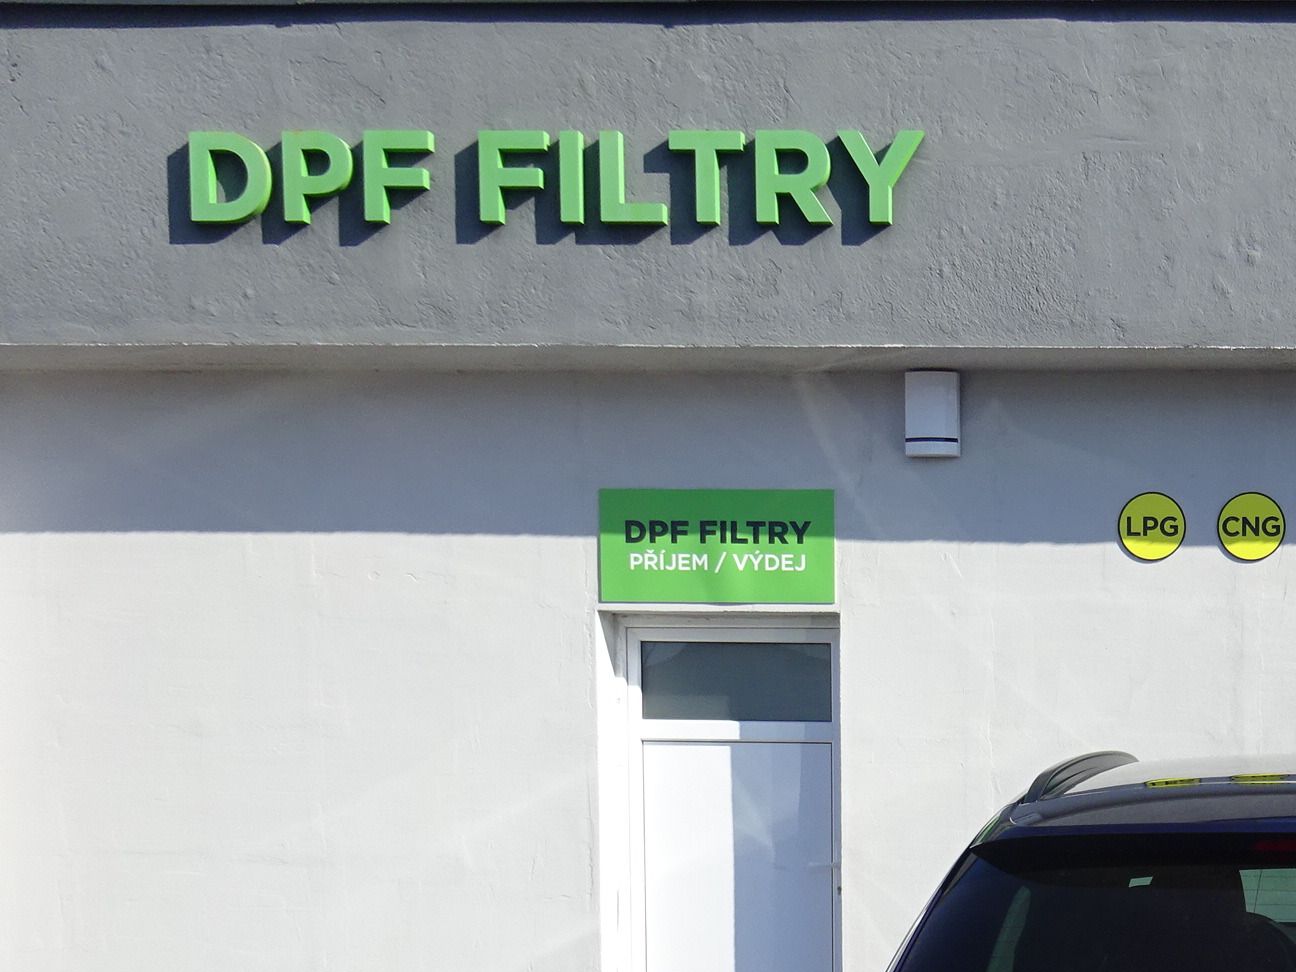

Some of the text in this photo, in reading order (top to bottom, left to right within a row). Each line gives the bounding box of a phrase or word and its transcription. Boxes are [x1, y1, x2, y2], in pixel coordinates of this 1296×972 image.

[188, 129, 926, 227] DPF FILTRY
[624, 519, 812, 545] DPF FILTRY
[1126, 515, 1179, 538] LPG
[1221, 515, 1281, 538] CNG
[629, 549, 807, 574] PŘÍJEM / VÝDEJ
